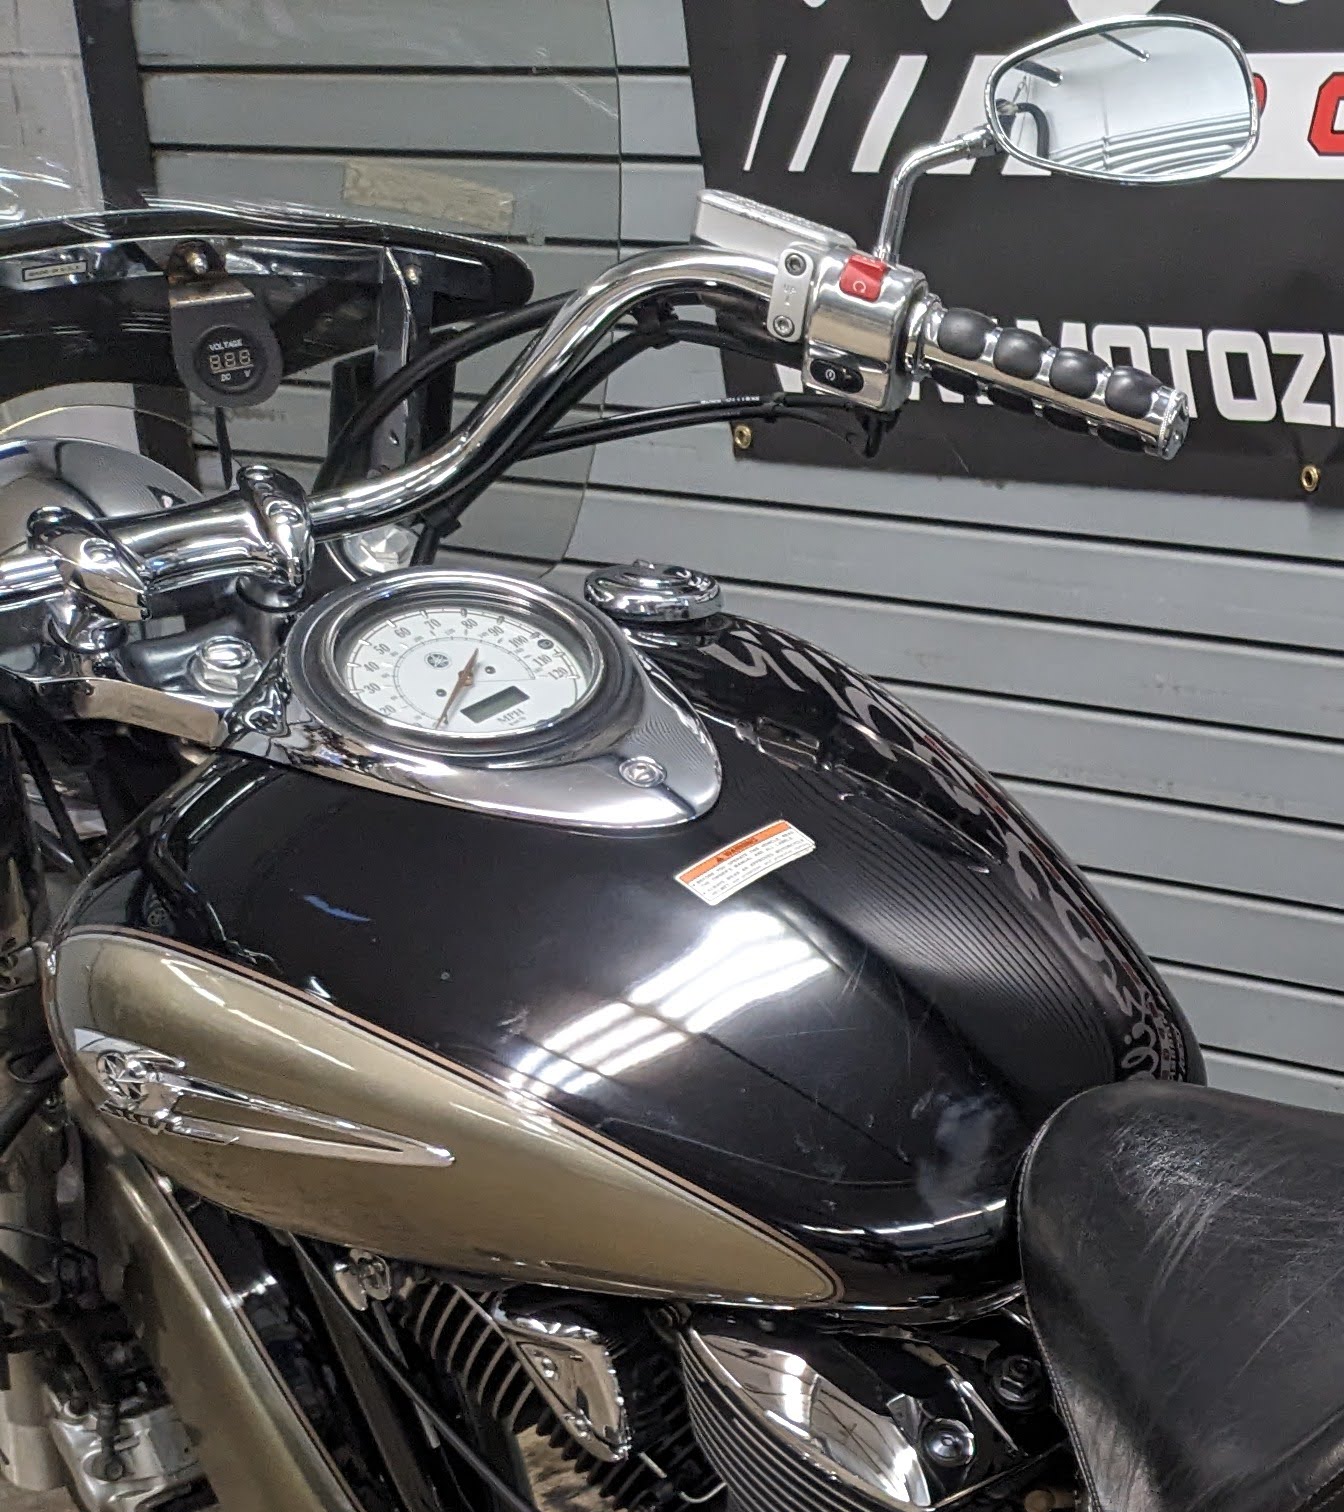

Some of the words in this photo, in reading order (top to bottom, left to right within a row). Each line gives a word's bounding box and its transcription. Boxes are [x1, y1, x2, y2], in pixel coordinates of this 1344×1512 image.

[424, 618, 441, 630] 70
[460, 618, 478, 630] 80
[394, 627, 412, 639] 60
[487, 625, 505, 637] 90
[508, 634, 529, 648] 100
[373, 643, 391, 655] 50
[547, 666, 569, 680] 120
[363, 682, 381, 695] 30
